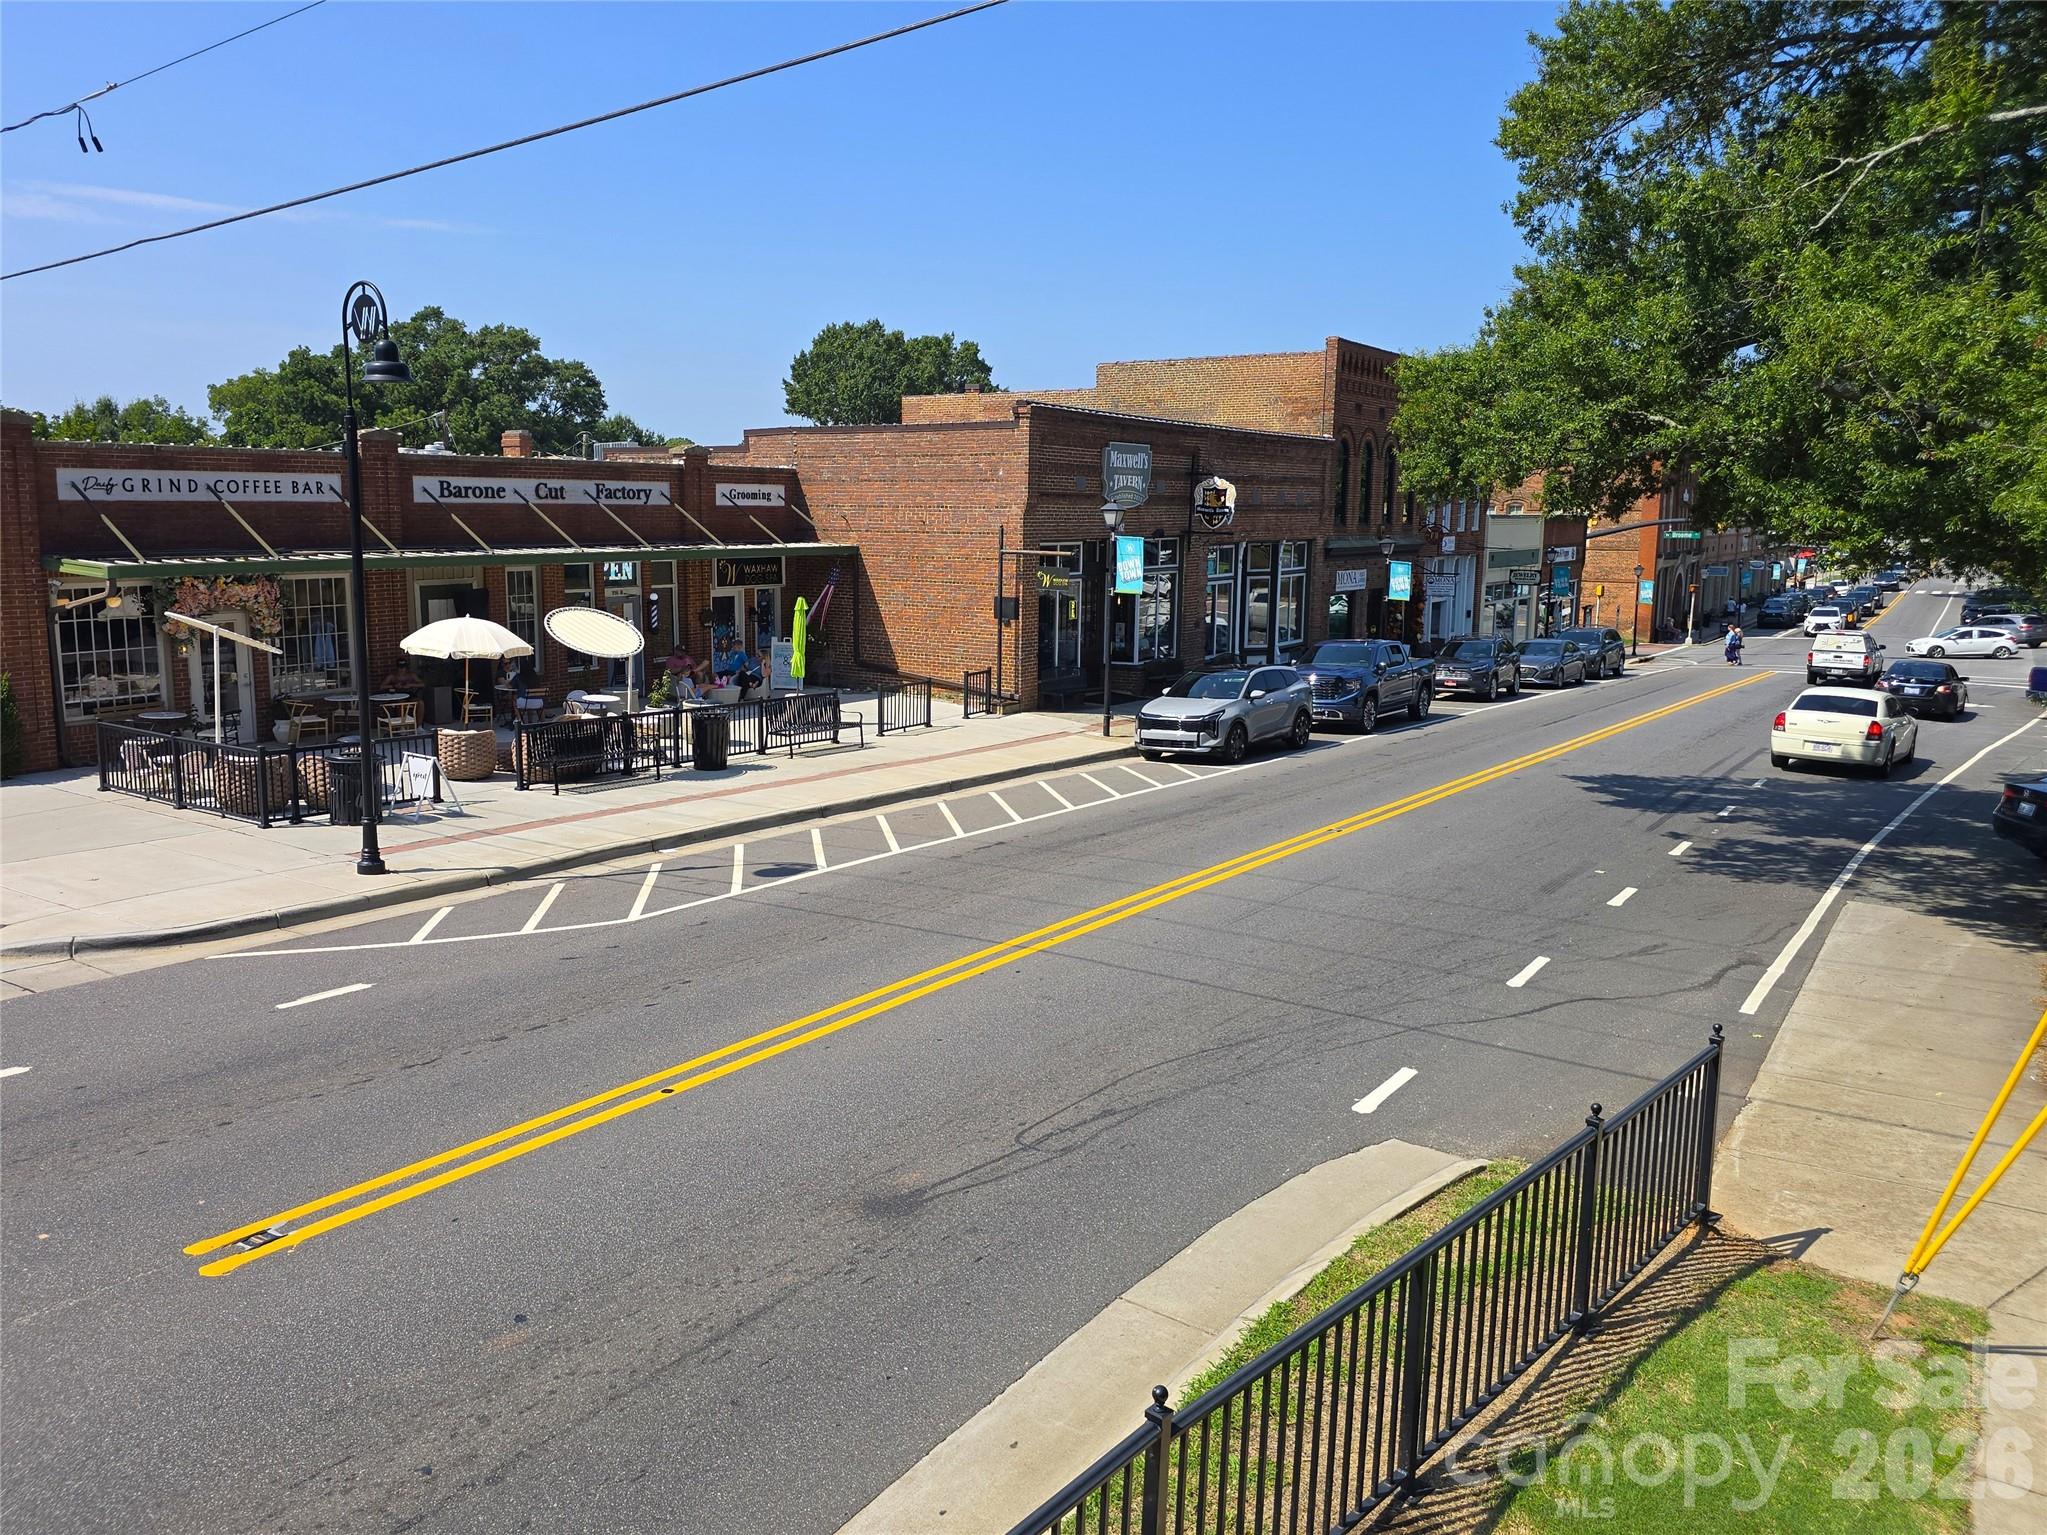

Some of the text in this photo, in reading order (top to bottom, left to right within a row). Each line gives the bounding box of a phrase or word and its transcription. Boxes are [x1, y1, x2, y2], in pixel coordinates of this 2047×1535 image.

[1110, 451, 1149, 469] Maxwell's
[82, 476, 325, 495] Daily GRIND COFFEE BAR
[1113, 474, 1144, 491] TAVERN
[438, 480, 653, 504] Barone Cut Factory
[729, 488, 772, 502] Grooming
[604, 562, 632, 580] PEN
[743, 563, 778, 574] WAXHAW
[1117, 558, 1140, 571] DOWN
[1119, 566, 1142, 580] TOWN
[1336, 571, 1357, 585] MONA
